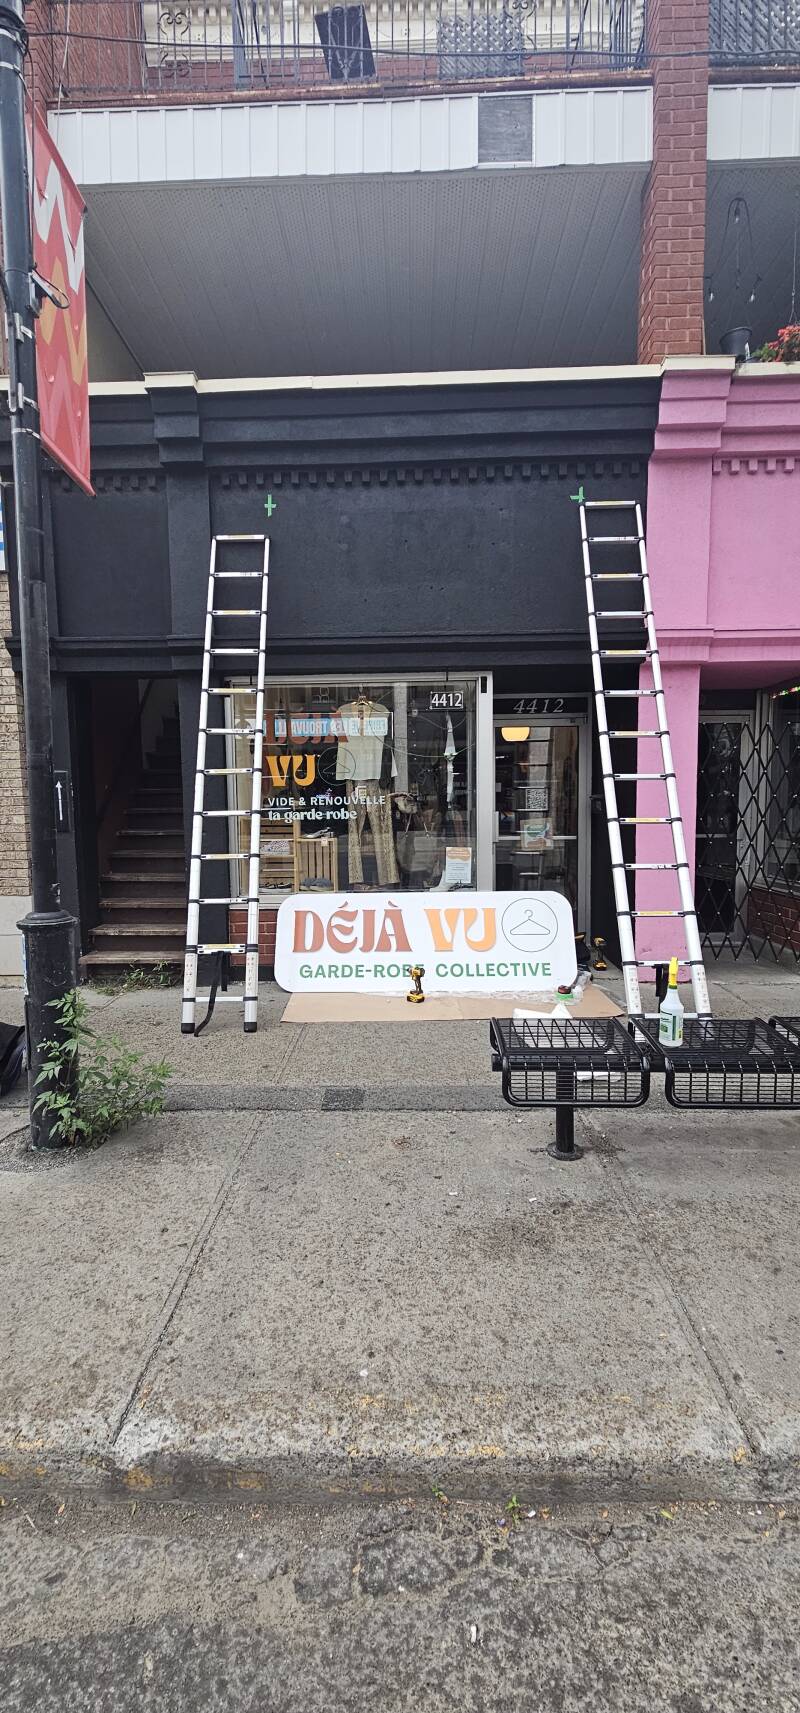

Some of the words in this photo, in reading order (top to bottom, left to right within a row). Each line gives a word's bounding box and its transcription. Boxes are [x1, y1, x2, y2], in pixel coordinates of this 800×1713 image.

[431, 692, 463, 708] 4412
[512, 698, 565, 714] 4412
[265, 754, 316, 787] VU
[268, 796, 295, 807] VIDE
[299, 796, 307, 806] &
[310, 795, 386, 806] RENOUVELLE
[268, 810, 281, 821] ta
[292, 901, 413, 954] DÉJÀ
[423, 907, 497, 953] VU
[435, 962, 552, 978] COLLECTIVE
